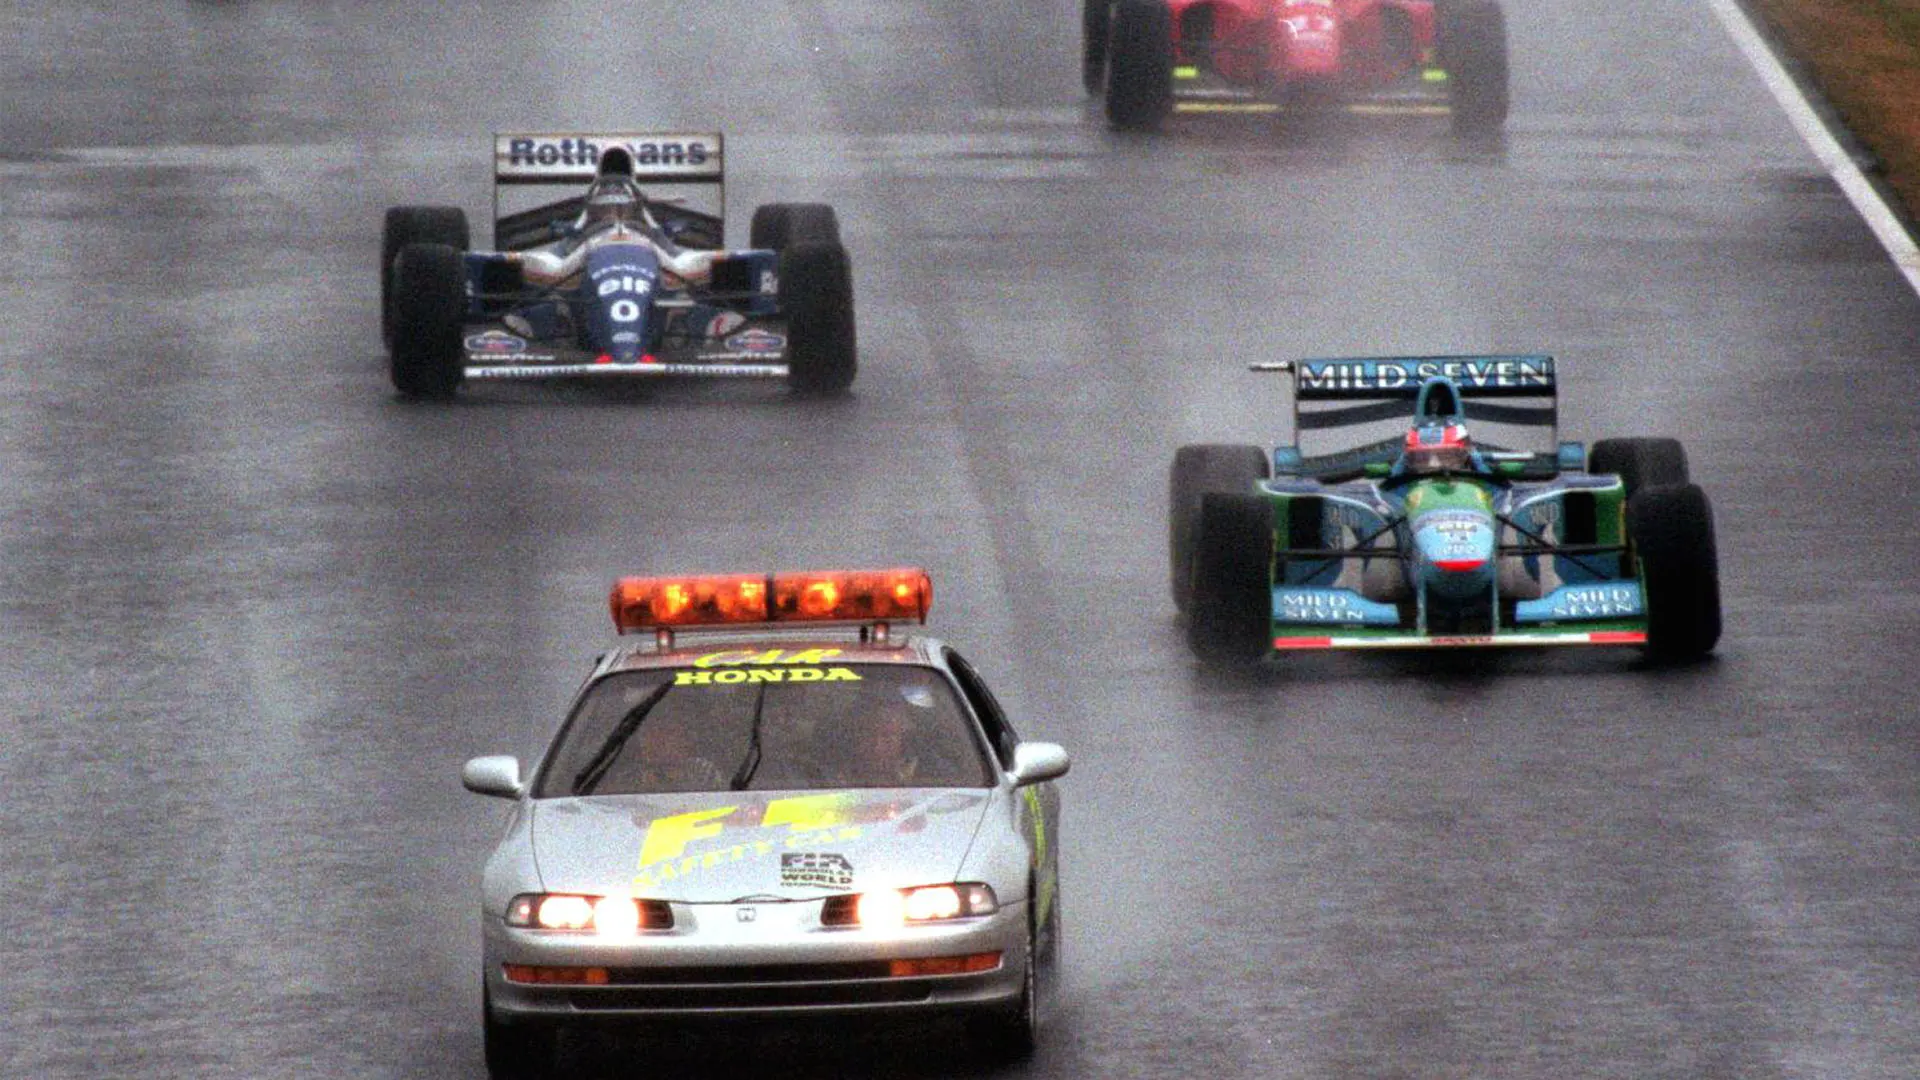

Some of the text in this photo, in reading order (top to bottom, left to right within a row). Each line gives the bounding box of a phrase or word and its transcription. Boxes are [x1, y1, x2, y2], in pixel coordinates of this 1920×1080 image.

[510, 138, 708, 166] Rothans
[610, 299, 640, 322] 0
[1301, 363, 1407, 389] MILD
[1418, 361, 1547, 388] SEVEN
[1283, 594, 1346, 608] MILD
[1564, 588, 1631, 602] MILD
[1285, 608, 1363, 620] SEVEN
[1553, 602, 1632, 616] SEVEN
[674, 667, 863, 686] HONDA
[781, 874, 853, 884] WORLD
